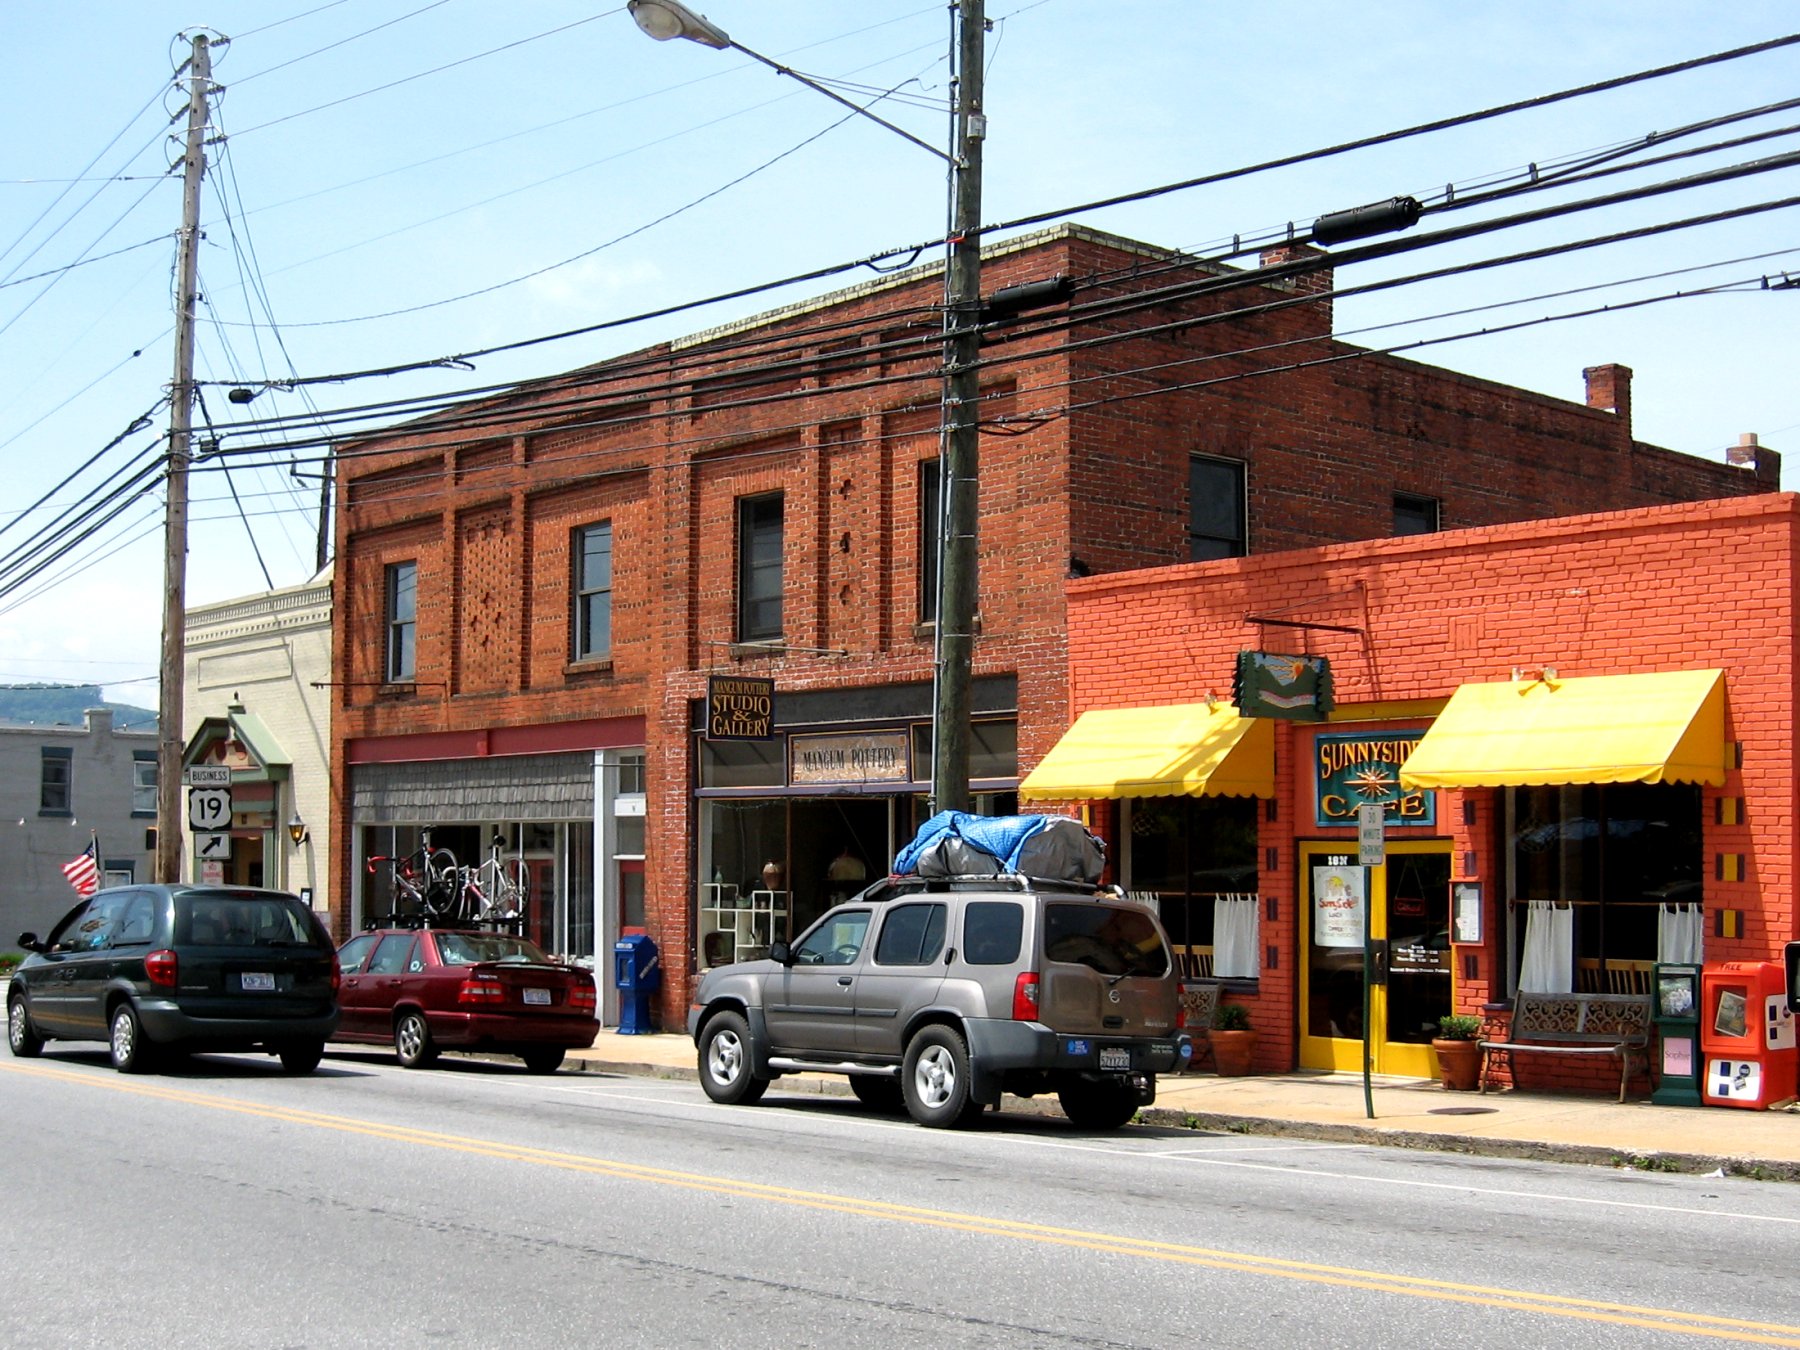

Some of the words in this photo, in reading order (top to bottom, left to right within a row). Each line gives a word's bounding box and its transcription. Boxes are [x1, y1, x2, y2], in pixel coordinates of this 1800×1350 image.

[714, 681, 743, 694] MANGUM
[743, 682, 771, 695] POTTERY
[713, 695, 771, 716] STUDIO
[733, 710, 752, 721] &
[712, 716, 770, 736] GALLERY
[803, 749, 845, 771] MANGUM
[852, 747, 897, 769] POTTERY
[192, 771, 228, 781] BUSINESS
[199, 798, 222, 820] 19
